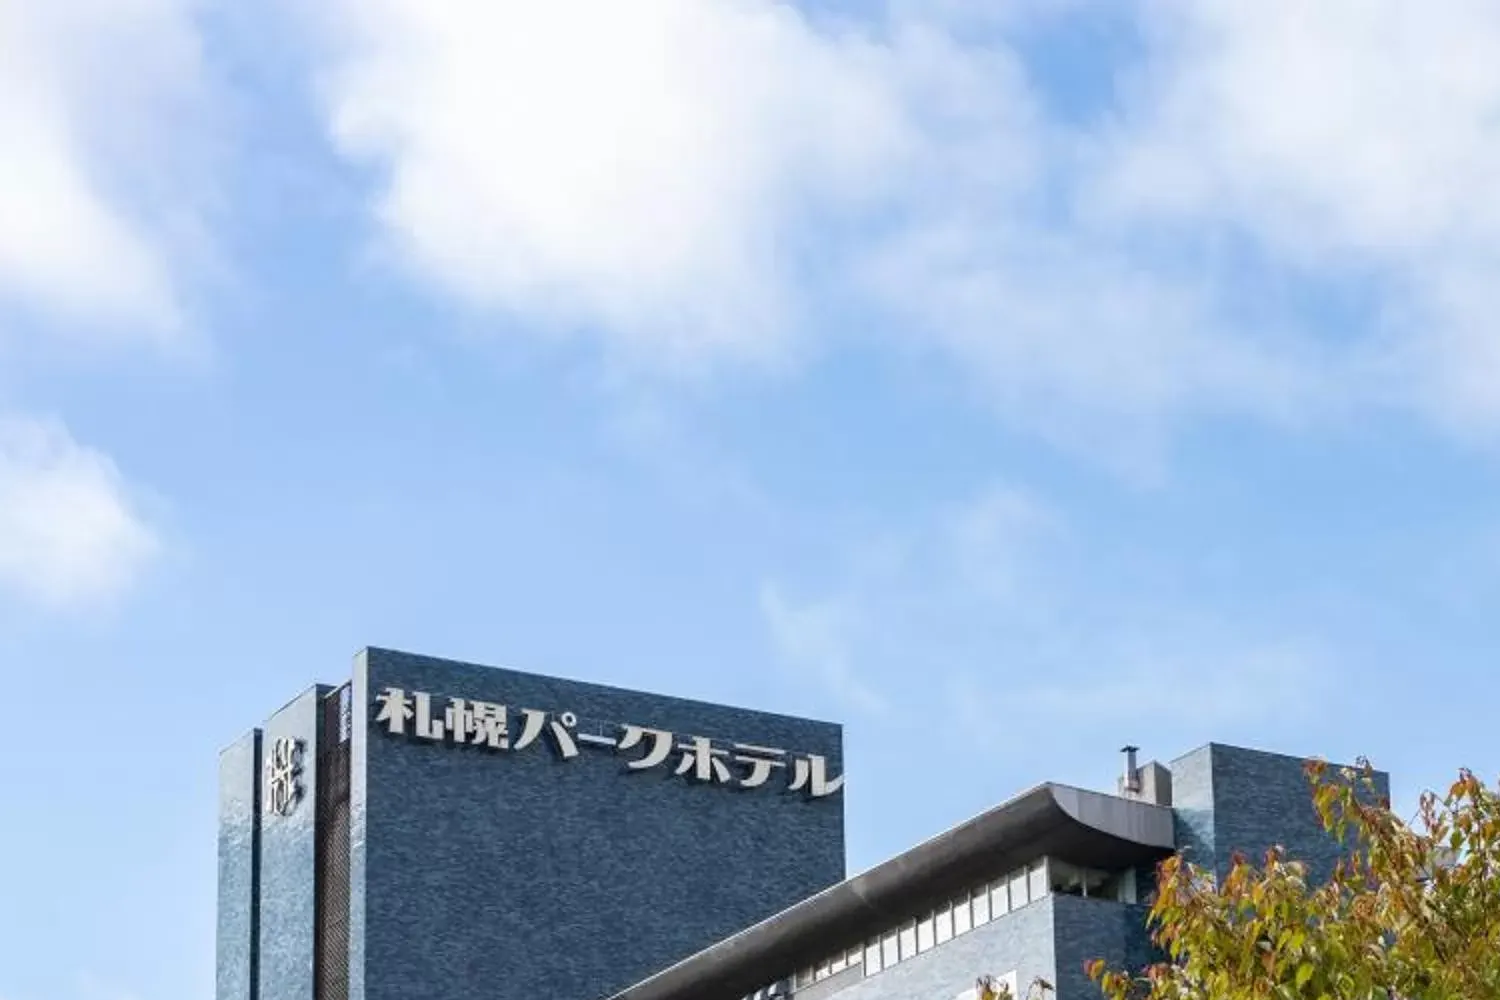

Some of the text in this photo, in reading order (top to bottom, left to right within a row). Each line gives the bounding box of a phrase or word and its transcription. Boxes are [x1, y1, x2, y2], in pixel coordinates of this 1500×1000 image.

[375, 687, 845, 797] 札幌パークホテル
